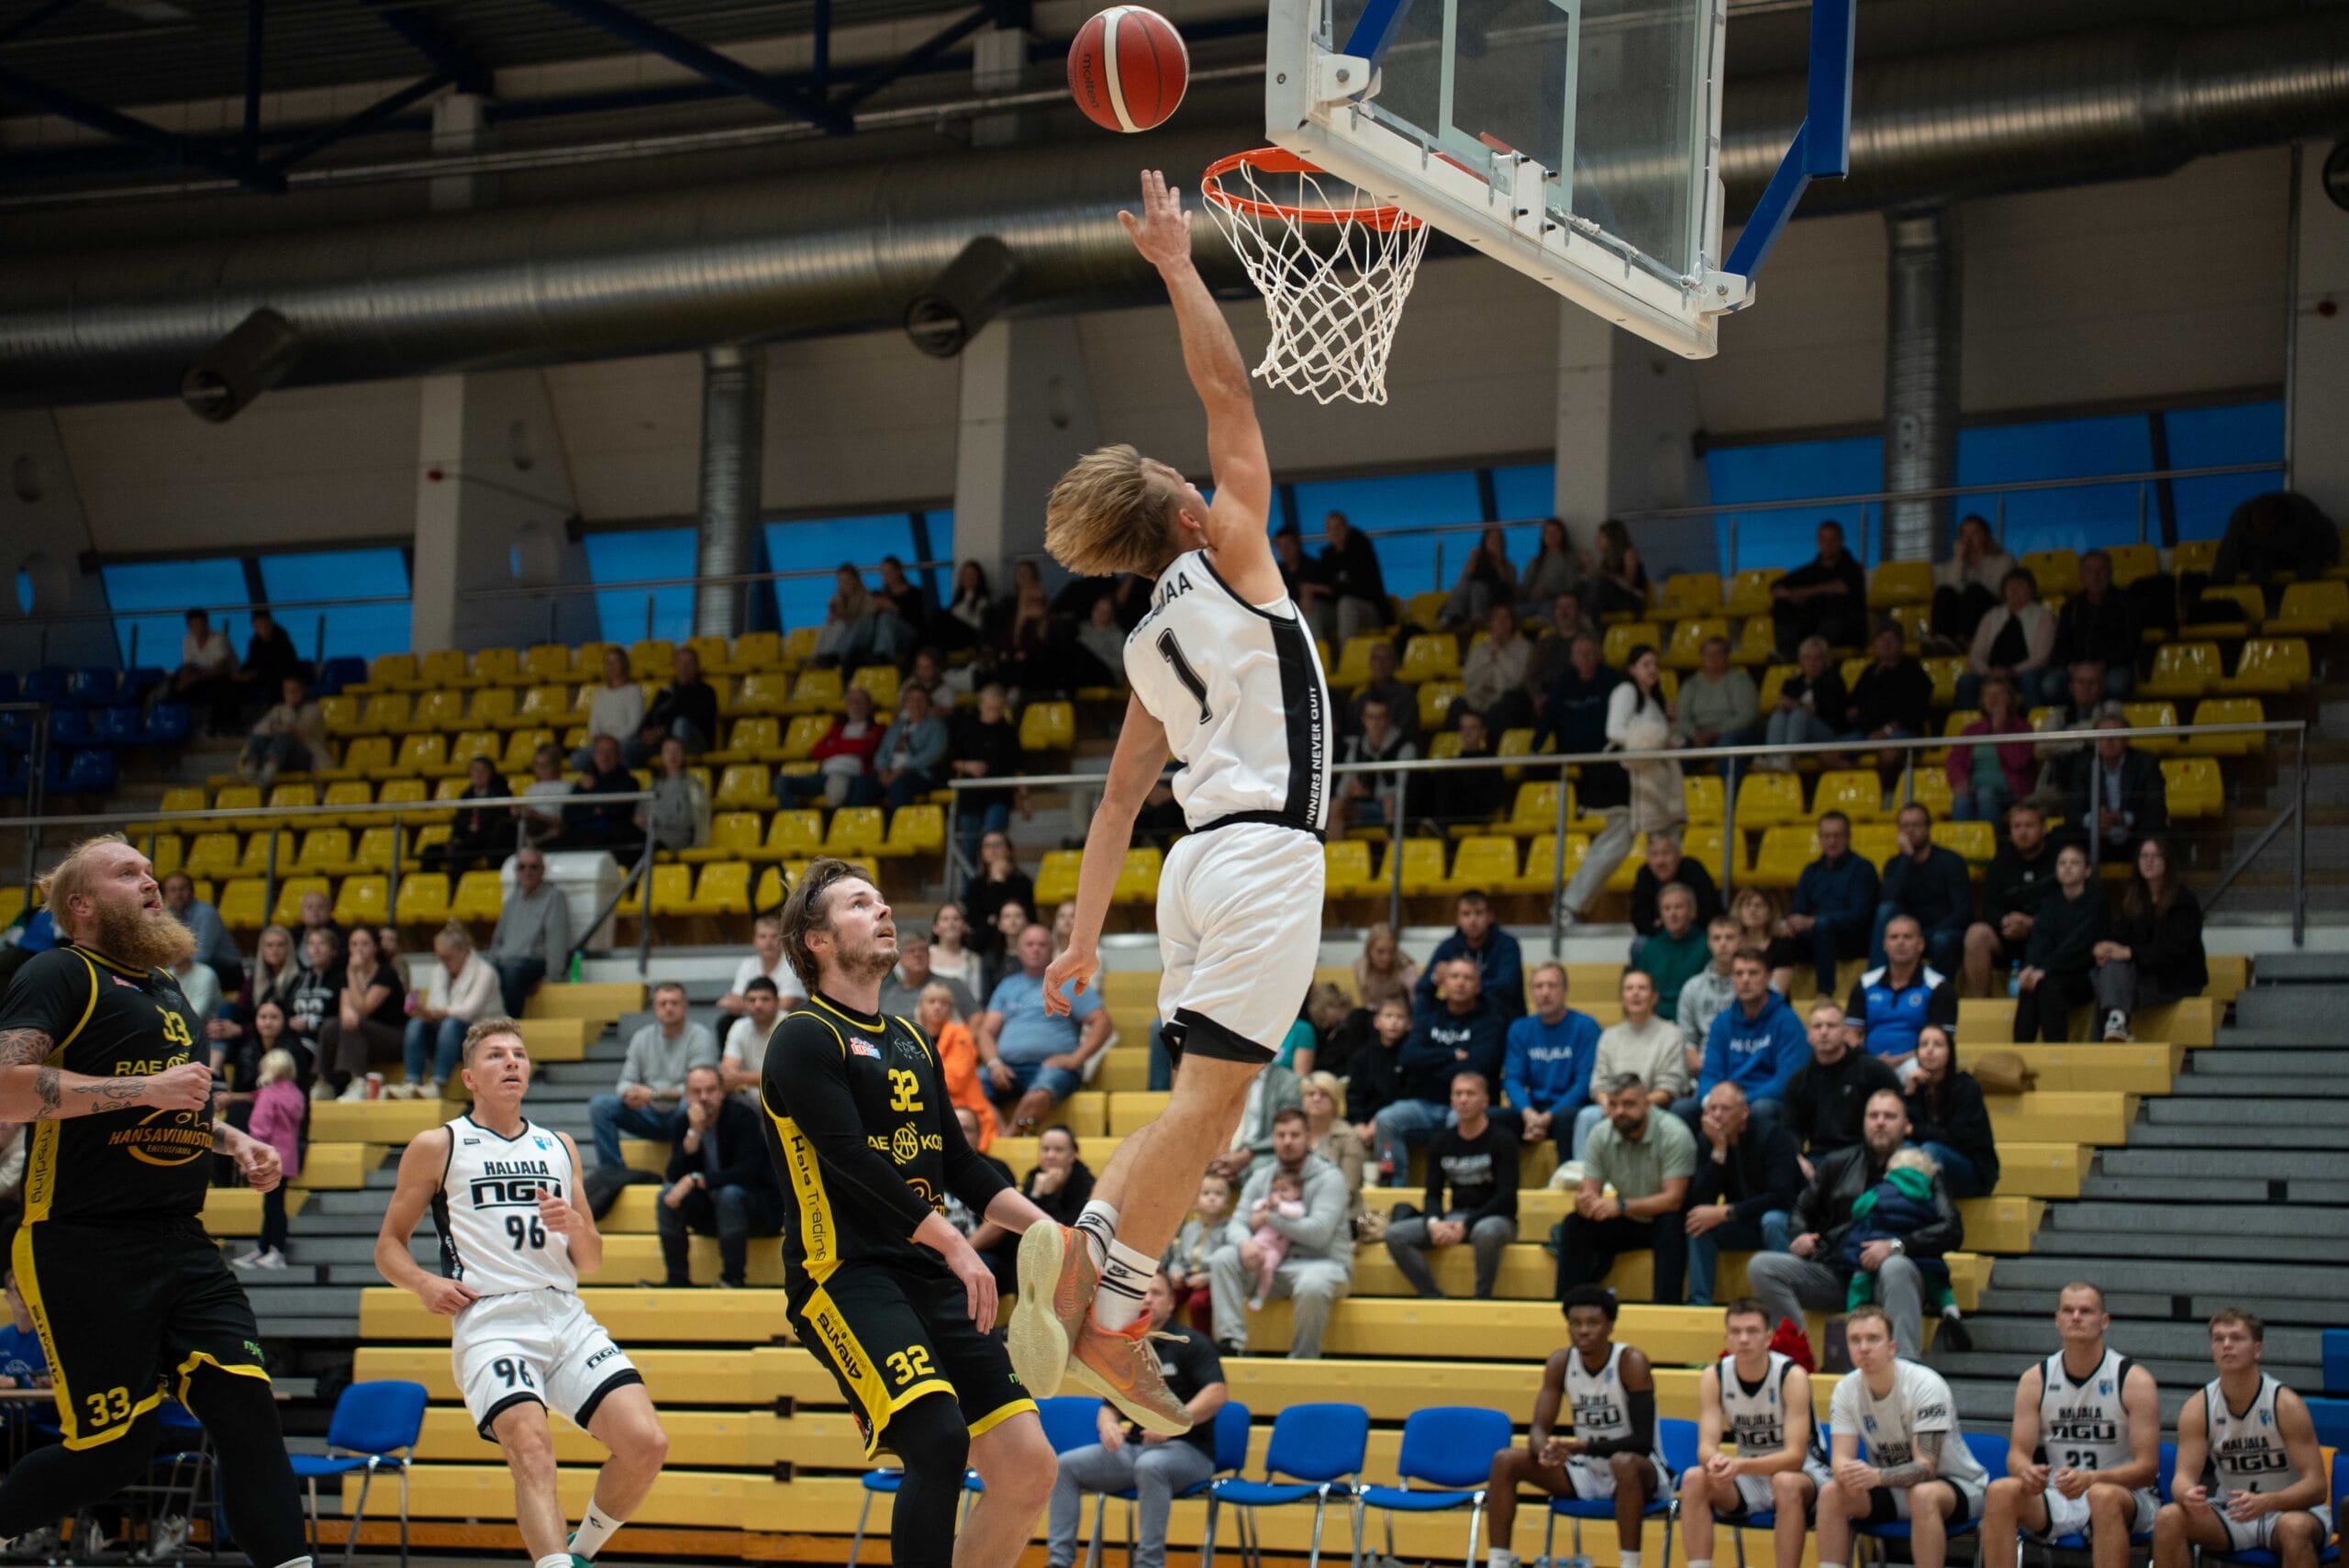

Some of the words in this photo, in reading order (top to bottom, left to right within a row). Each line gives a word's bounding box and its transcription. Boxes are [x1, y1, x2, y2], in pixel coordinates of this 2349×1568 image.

[1156, 628, 1212, 726] 1
[1309, 685, 1319, 721] QUIT
[1311, 723, 1322, 770] NEVER
[1306, 773, 1321, 825] INNERS
[155, 1005, 193, 1046] 33
[115, 1059, 162, 1076] RAE
[888, 1068, 924, 1112] 32
[868, 1135, 890, 1151] AE
[484, 1161, 549, 1175] HALJALA
[505, 1215, 546, 1251] 96
[807, 1189, 827, 1262] Trading
[493, 1358, 534, 1388] 96
[886, 1345, 935, 1385] 32
[86, 1386, 131, 1427] 33
